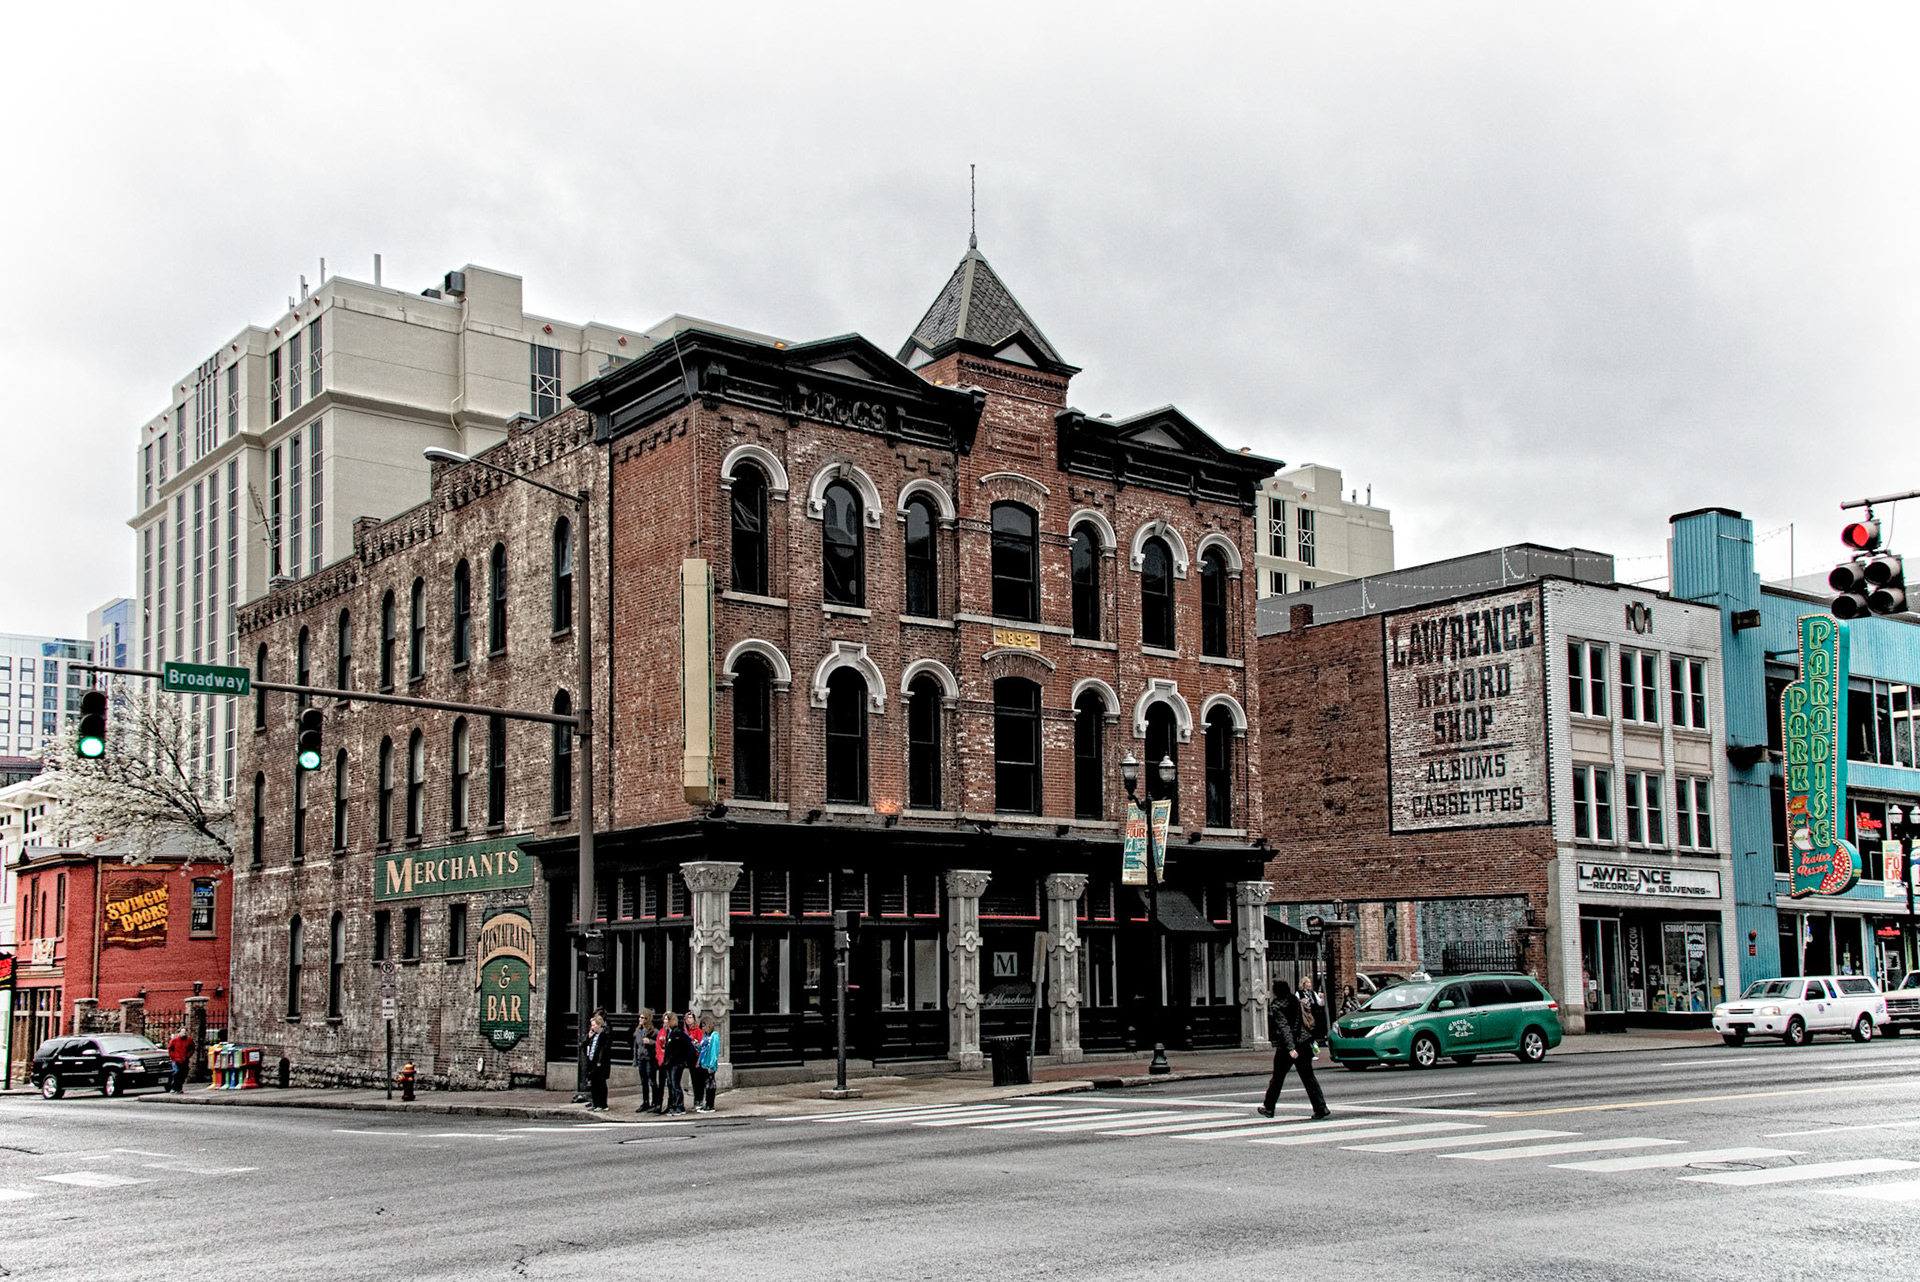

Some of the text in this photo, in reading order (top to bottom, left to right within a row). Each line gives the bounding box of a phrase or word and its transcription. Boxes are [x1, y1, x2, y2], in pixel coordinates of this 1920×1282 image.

[801, 391, 887, 430] DRUGS
[1389, 600, 1535, 668] LAWRENCE
[169, 669, 245, 691] Broadway
[1416, 663, 1511, 708] RECORD
[1434, 705, 1493, 744] SHOP
[1788, 686, 1809, 792] PARK
[1809, 620, 1831, 848] PARADISE
[1426, 753, 1506, 784] ALBUMS
[1412, 786, 1523, 818] CASSETTES
[1126, 828, 1146, 839] FOUR
[384, 850, 519, 895] MERCHANTS
[1801, 852, 1833, 865] Trailer
[1579, 865, 1672, 884] LAWRENCE
[120, 903, 169, 932] DOORS
[1665, 924, 1684, 932] SING
[482, 923, 530, 959] RESTAURANT
[499, 965, 511, 989] &
[996, 954, 1016, 975] M
[487, 995, 522, 1022] BAR
